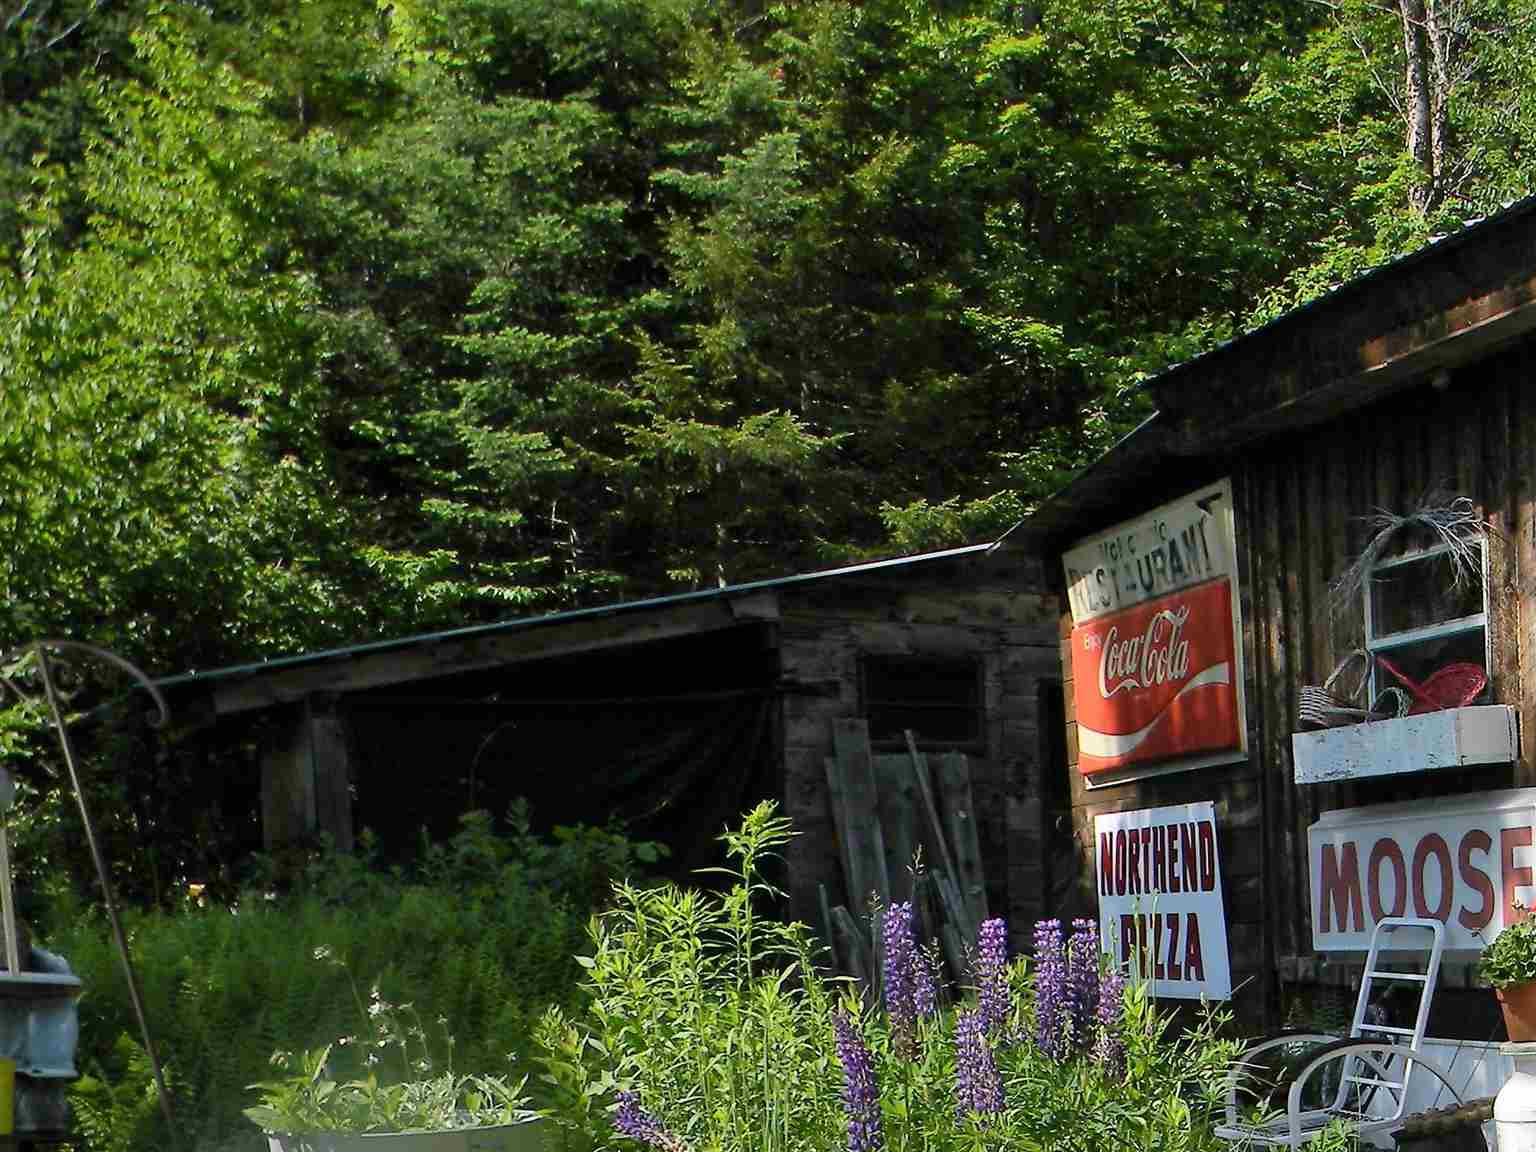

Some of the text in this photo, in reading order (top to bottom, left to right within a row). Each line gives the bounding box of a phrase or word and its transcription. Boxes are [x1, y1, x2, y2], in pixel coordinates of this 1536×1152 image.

[1101, 820, 1215, 896] NORTHEND
[1319, 826, 1534, 934] MOOSE
[1120, 913, 1205, 981] PIZZA
